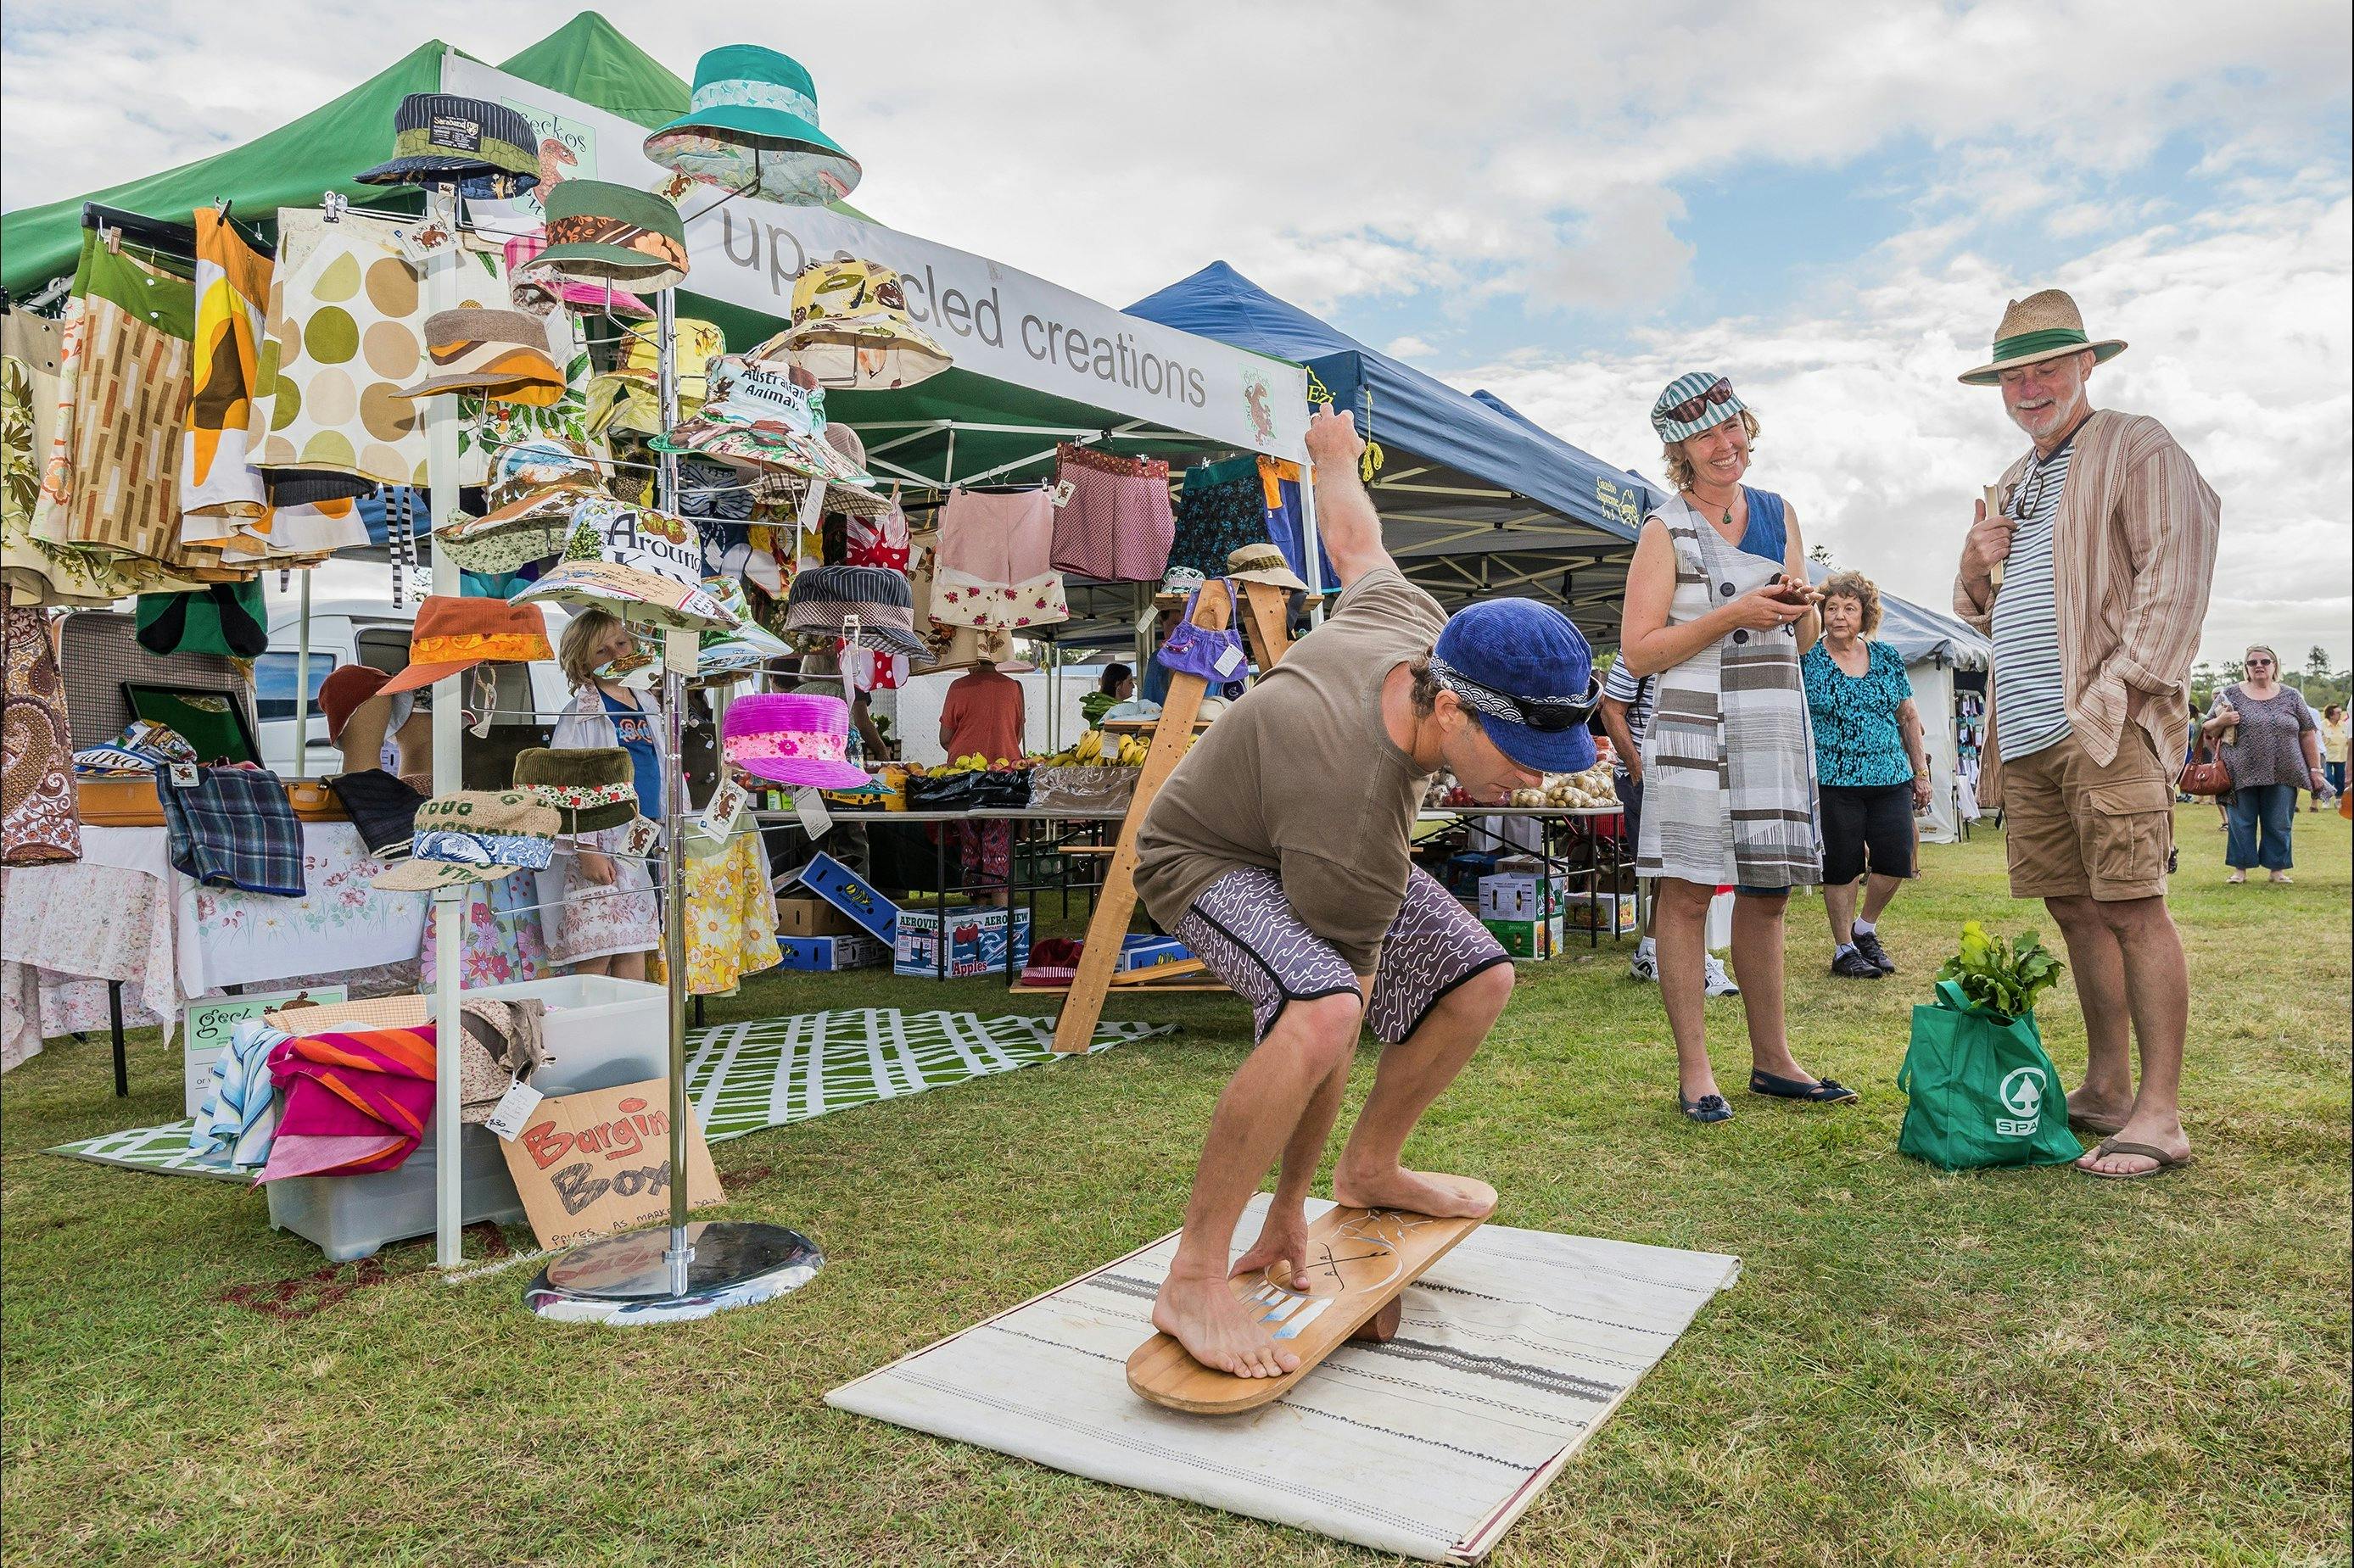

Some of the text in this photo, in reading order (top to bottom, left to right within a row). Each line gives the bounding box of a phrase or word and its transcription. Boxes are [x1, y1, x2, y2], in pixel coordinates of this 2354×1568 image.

[433, 116, 467, 129] Saraband
[1022, 312, 1207, 408] creations
[741, 369, 806, 401] Australian
[1596, 488, 1619, 508] Supreme
[900, 915, 939, 929] AEROVIE
[984, 912, 1029, 926] AEROIEW
[952, 959, 987, 977] Apples
[196, 1007, 252, 1040] geck
[489, 1118, 506, 1128] $30
[1999, 1121, 2038, 1133] SPA
[521, 1096, 670, 1171] Bargin
[551, 1159, 671, 1216] Box
[612, 1219, 628, 1230] AS
[636, 1208, 671, 1222] MARKE
